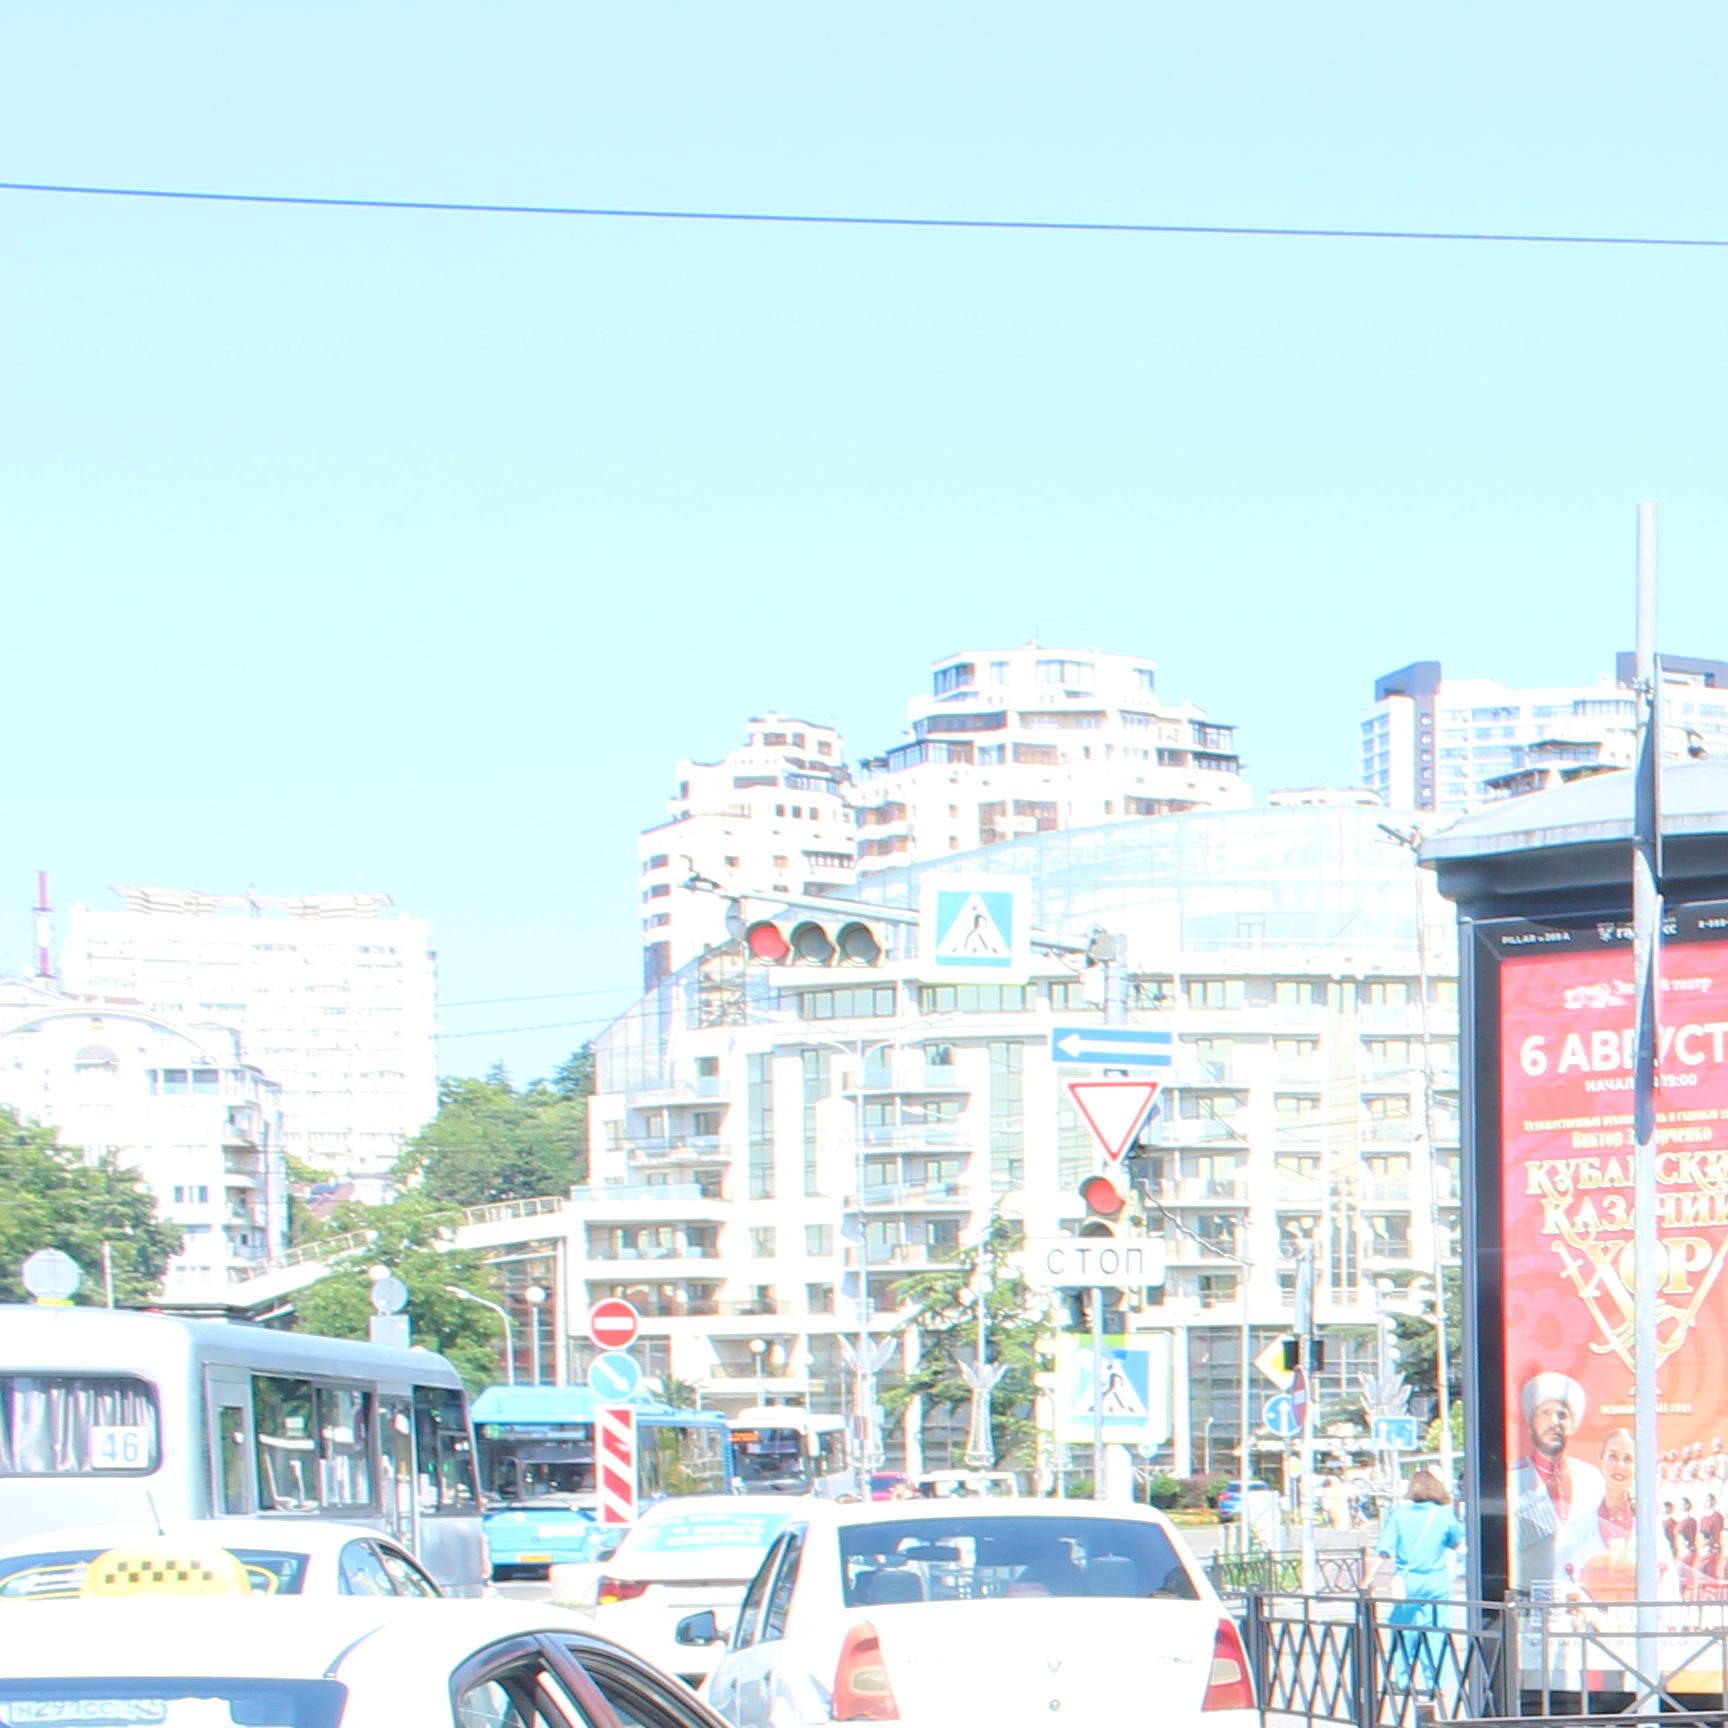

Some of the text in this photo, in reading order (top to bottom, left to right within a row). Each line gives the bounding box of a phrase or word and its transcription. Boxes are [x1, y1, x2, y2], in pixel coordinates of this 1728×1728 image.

[1520, 1035, 1547, 1076] 6
[1586, 1073, 1698, 1092] НАЧАЛ 19:00
[1572, 1131, 1622, 1149] Виктор
[1046, 1248, 1143, 1275] СТОП
[101, 1432, 138, 1464] 46
